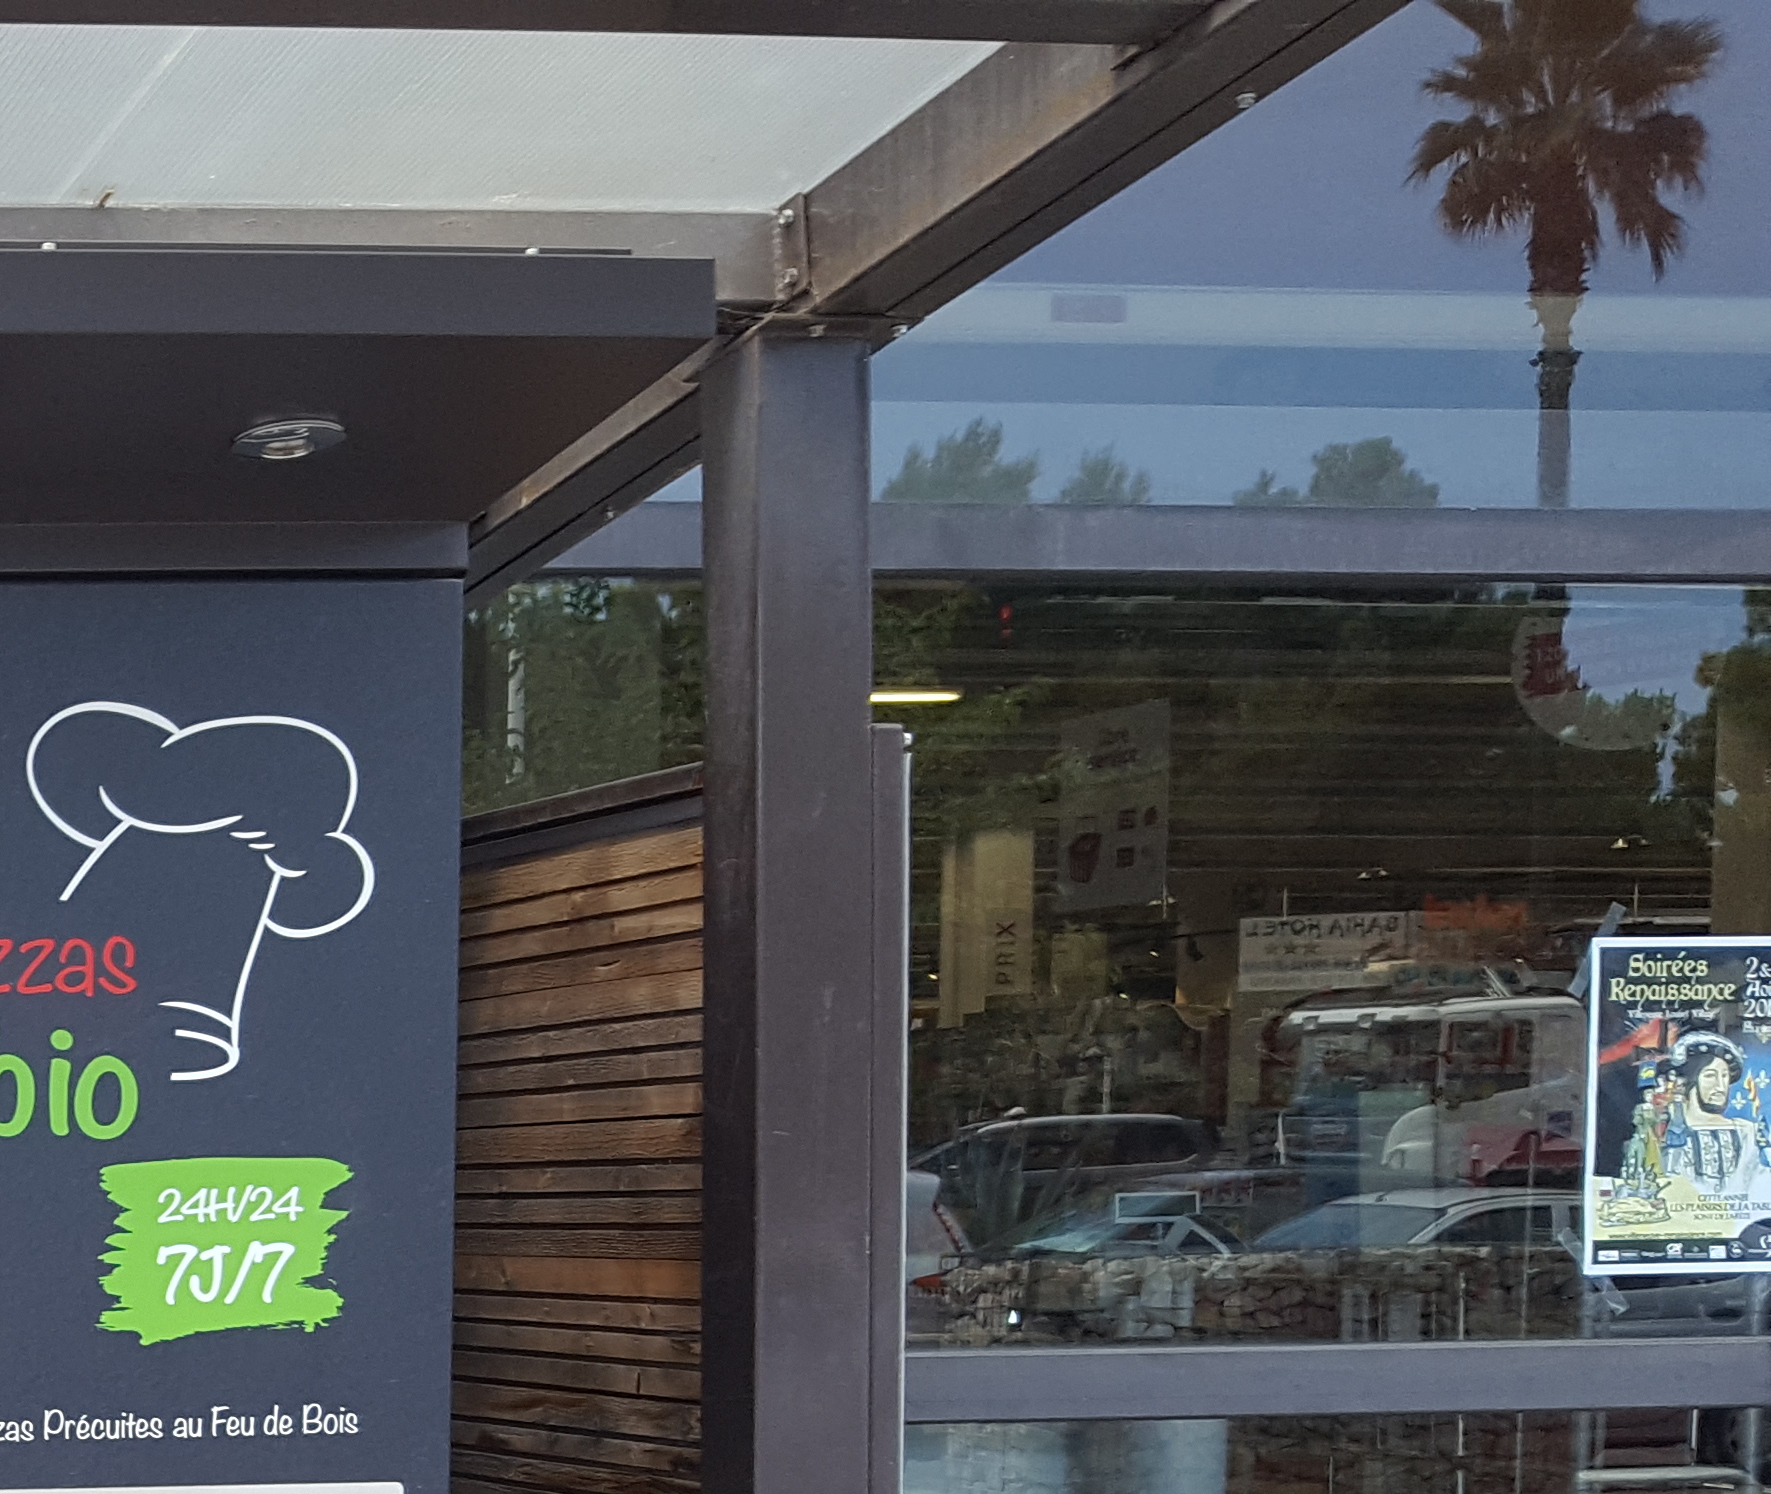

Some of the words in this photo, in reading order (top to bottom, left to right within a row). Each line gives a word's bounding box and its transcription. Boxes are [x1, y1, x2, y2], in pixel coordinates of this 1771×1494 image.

[1627, 951, 1708, 984] Soirées
[1609, 978, 1737, 1008] Renaissance
[157, 1184, 305, 1224] 24H/24
[157, 1240, 297, 1306] 7J/7
[43, 1408, 164, 1441] Précuites
[172, 1417, 203, 1439] au
[211, 1405, 255, 1437] Feu
[263, 1404, 294, 1436] de
[301, 1402, 359, 1435] Bois
